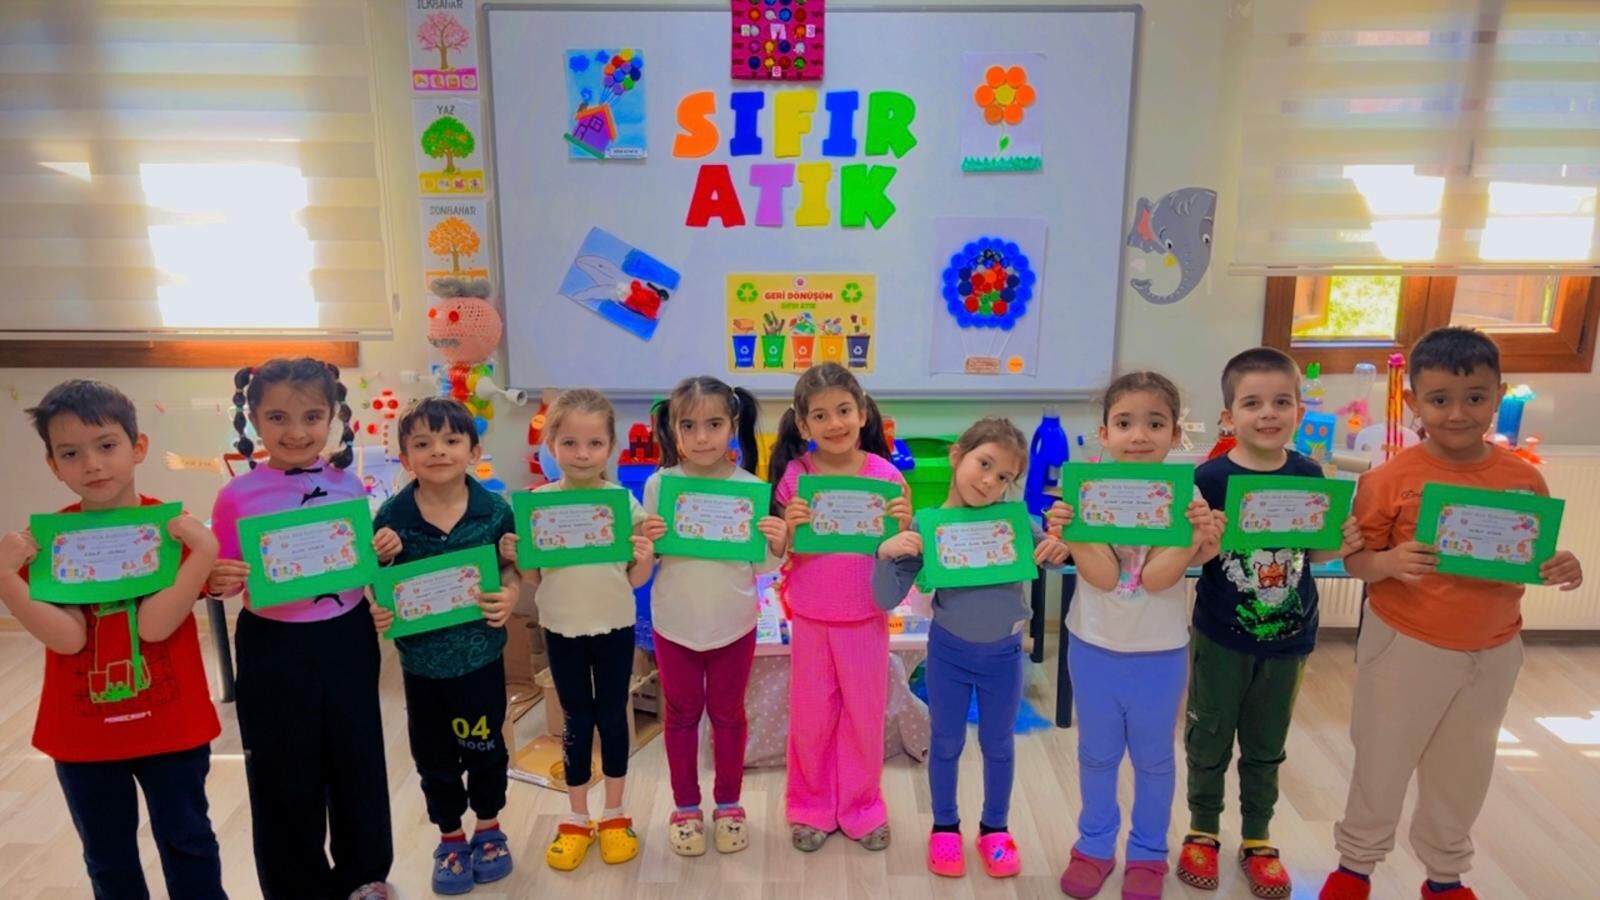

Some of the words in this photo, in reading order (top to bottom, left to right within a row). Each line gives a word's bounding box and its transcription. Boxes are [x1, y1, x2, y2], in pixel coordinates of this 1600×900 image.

[437, 105, 455, 115] YAZ
[672, 89, 917, 159] SIFIR
[685, 162, 897, 230] ATIK
[429, 205, 476, 216] SONBAHAR
[764, 291, 785, 300] GERİ
[787, 291, 833, 301] DÖNÜŞÜM
[452, 715, 490, 740] 04
[458, 739, 496, 751] ROCK
